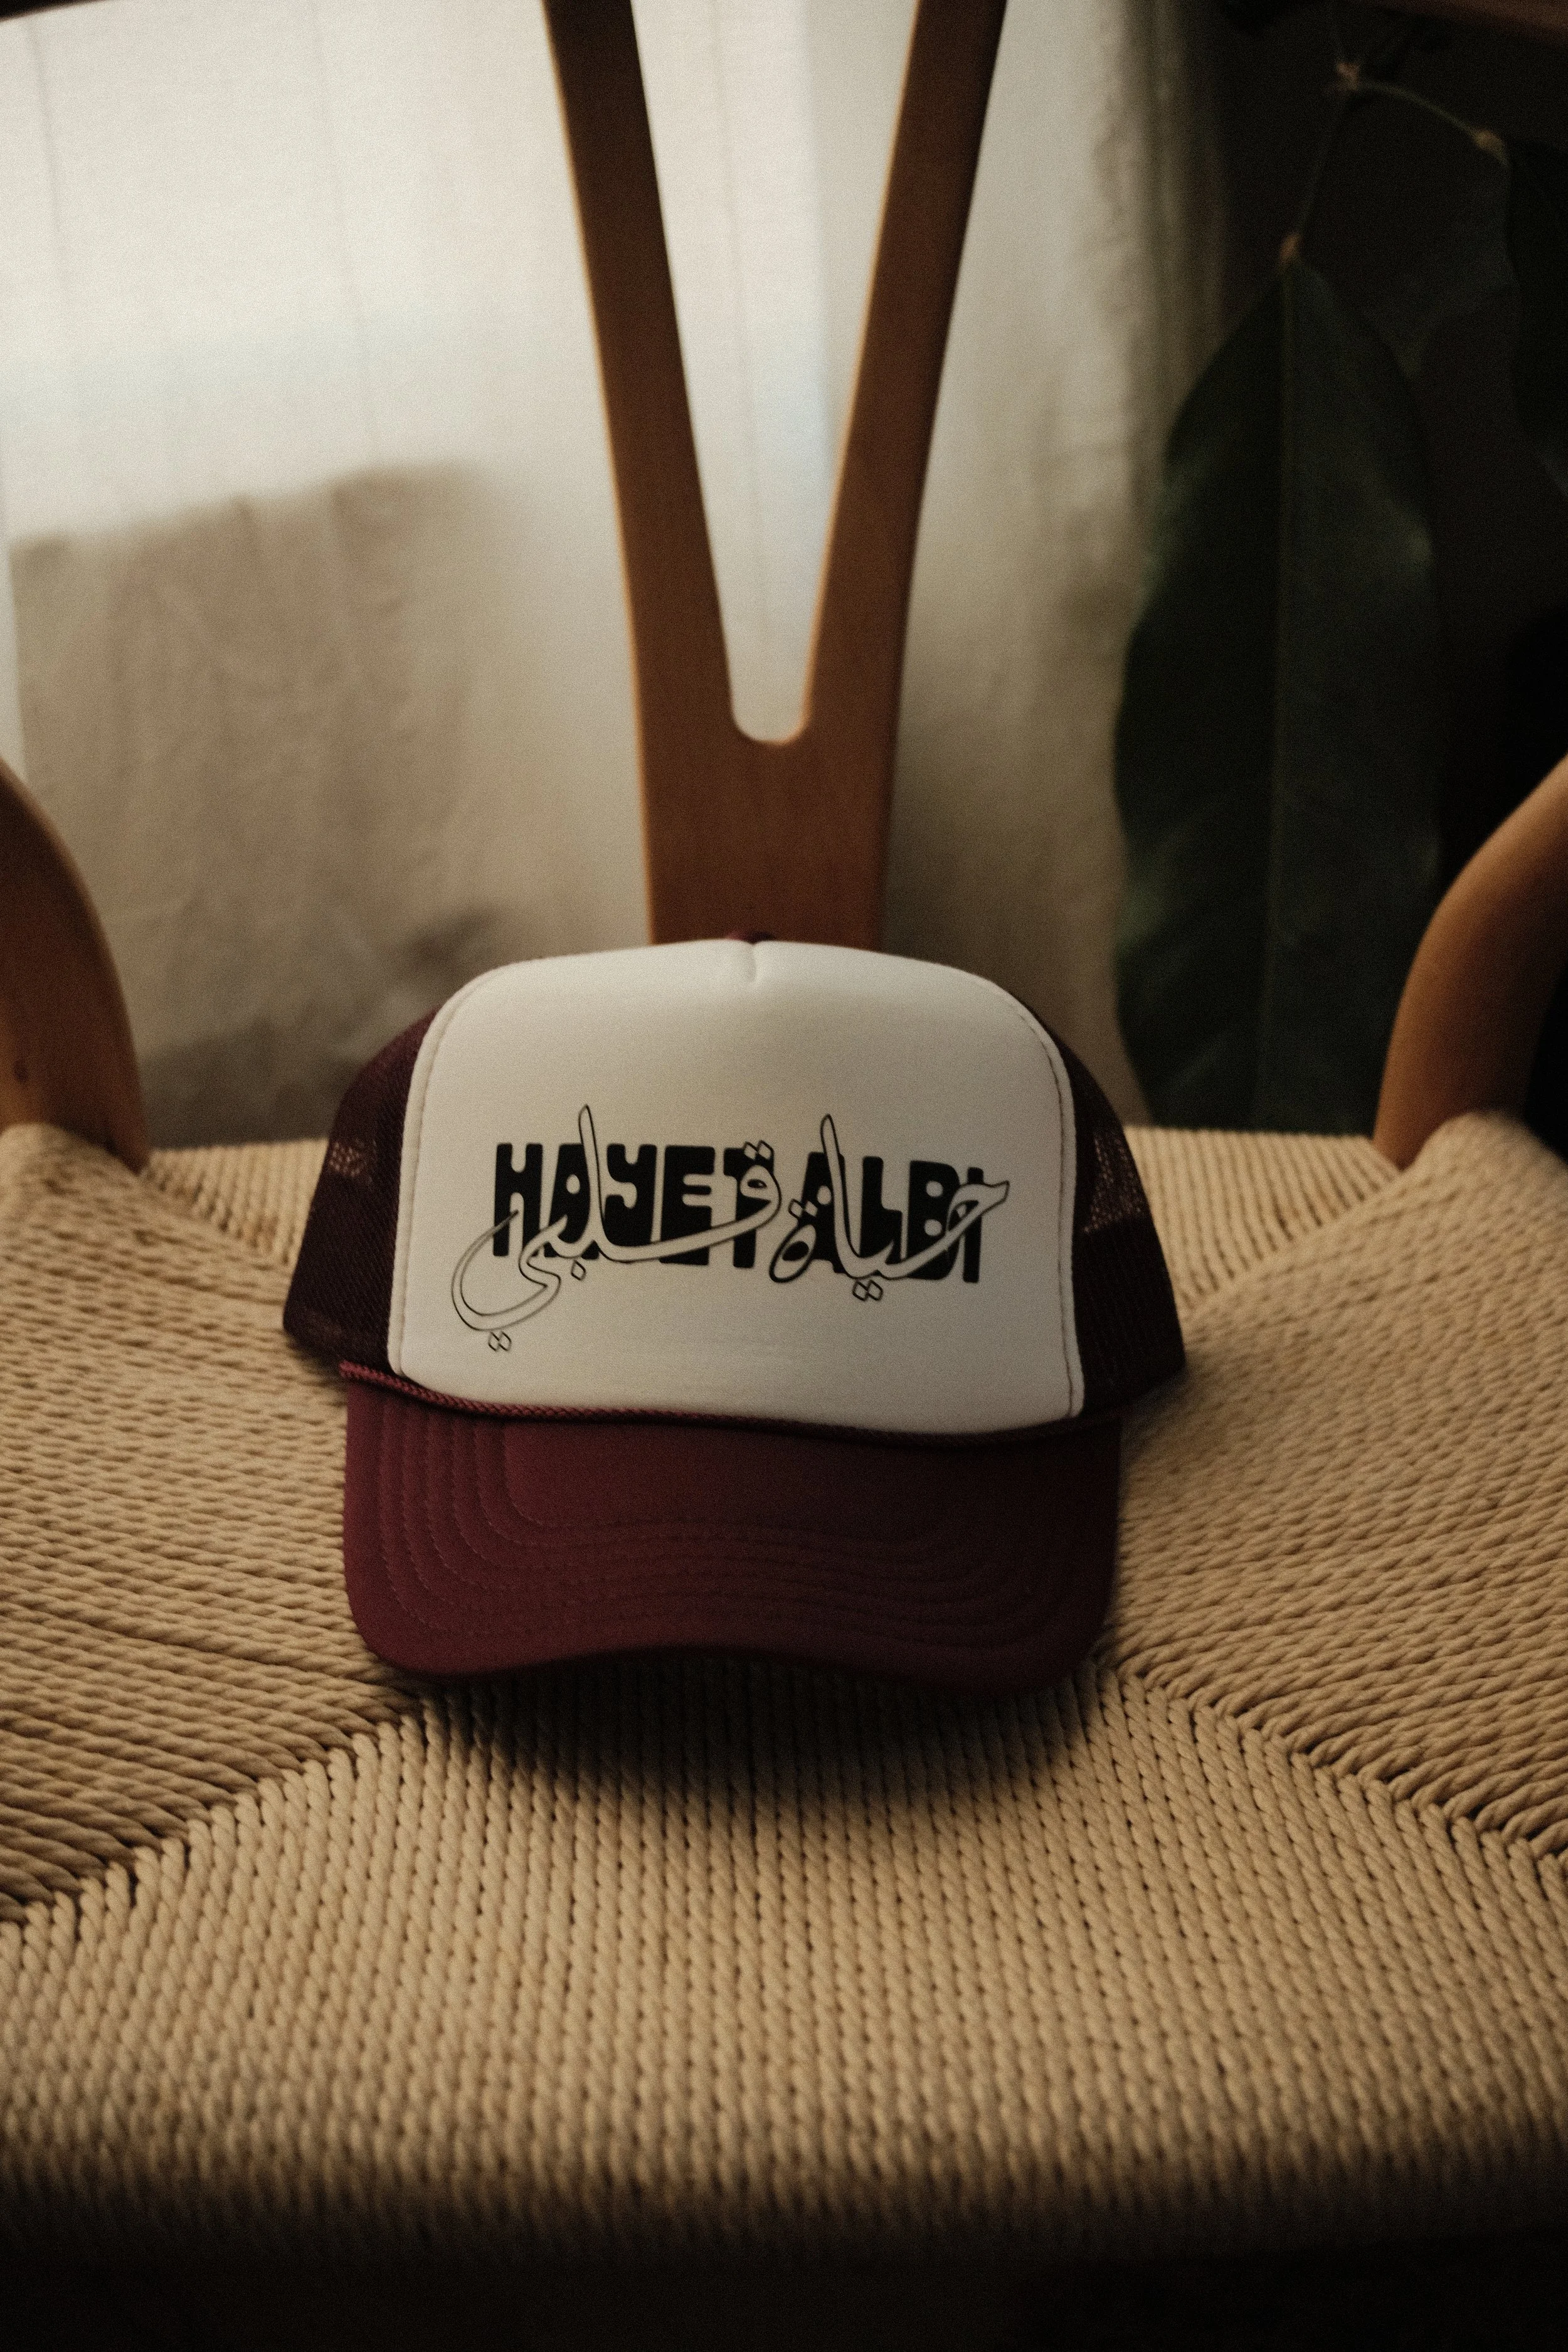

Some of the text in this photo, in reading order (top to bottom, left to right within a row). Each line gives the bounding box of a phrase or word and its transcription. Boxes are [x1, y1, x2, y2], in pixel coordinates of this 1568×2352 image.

[450, 1104, 1010, 1352] حياة قلبي
[492, 1142, 984, 1283] HAYET ALBI
